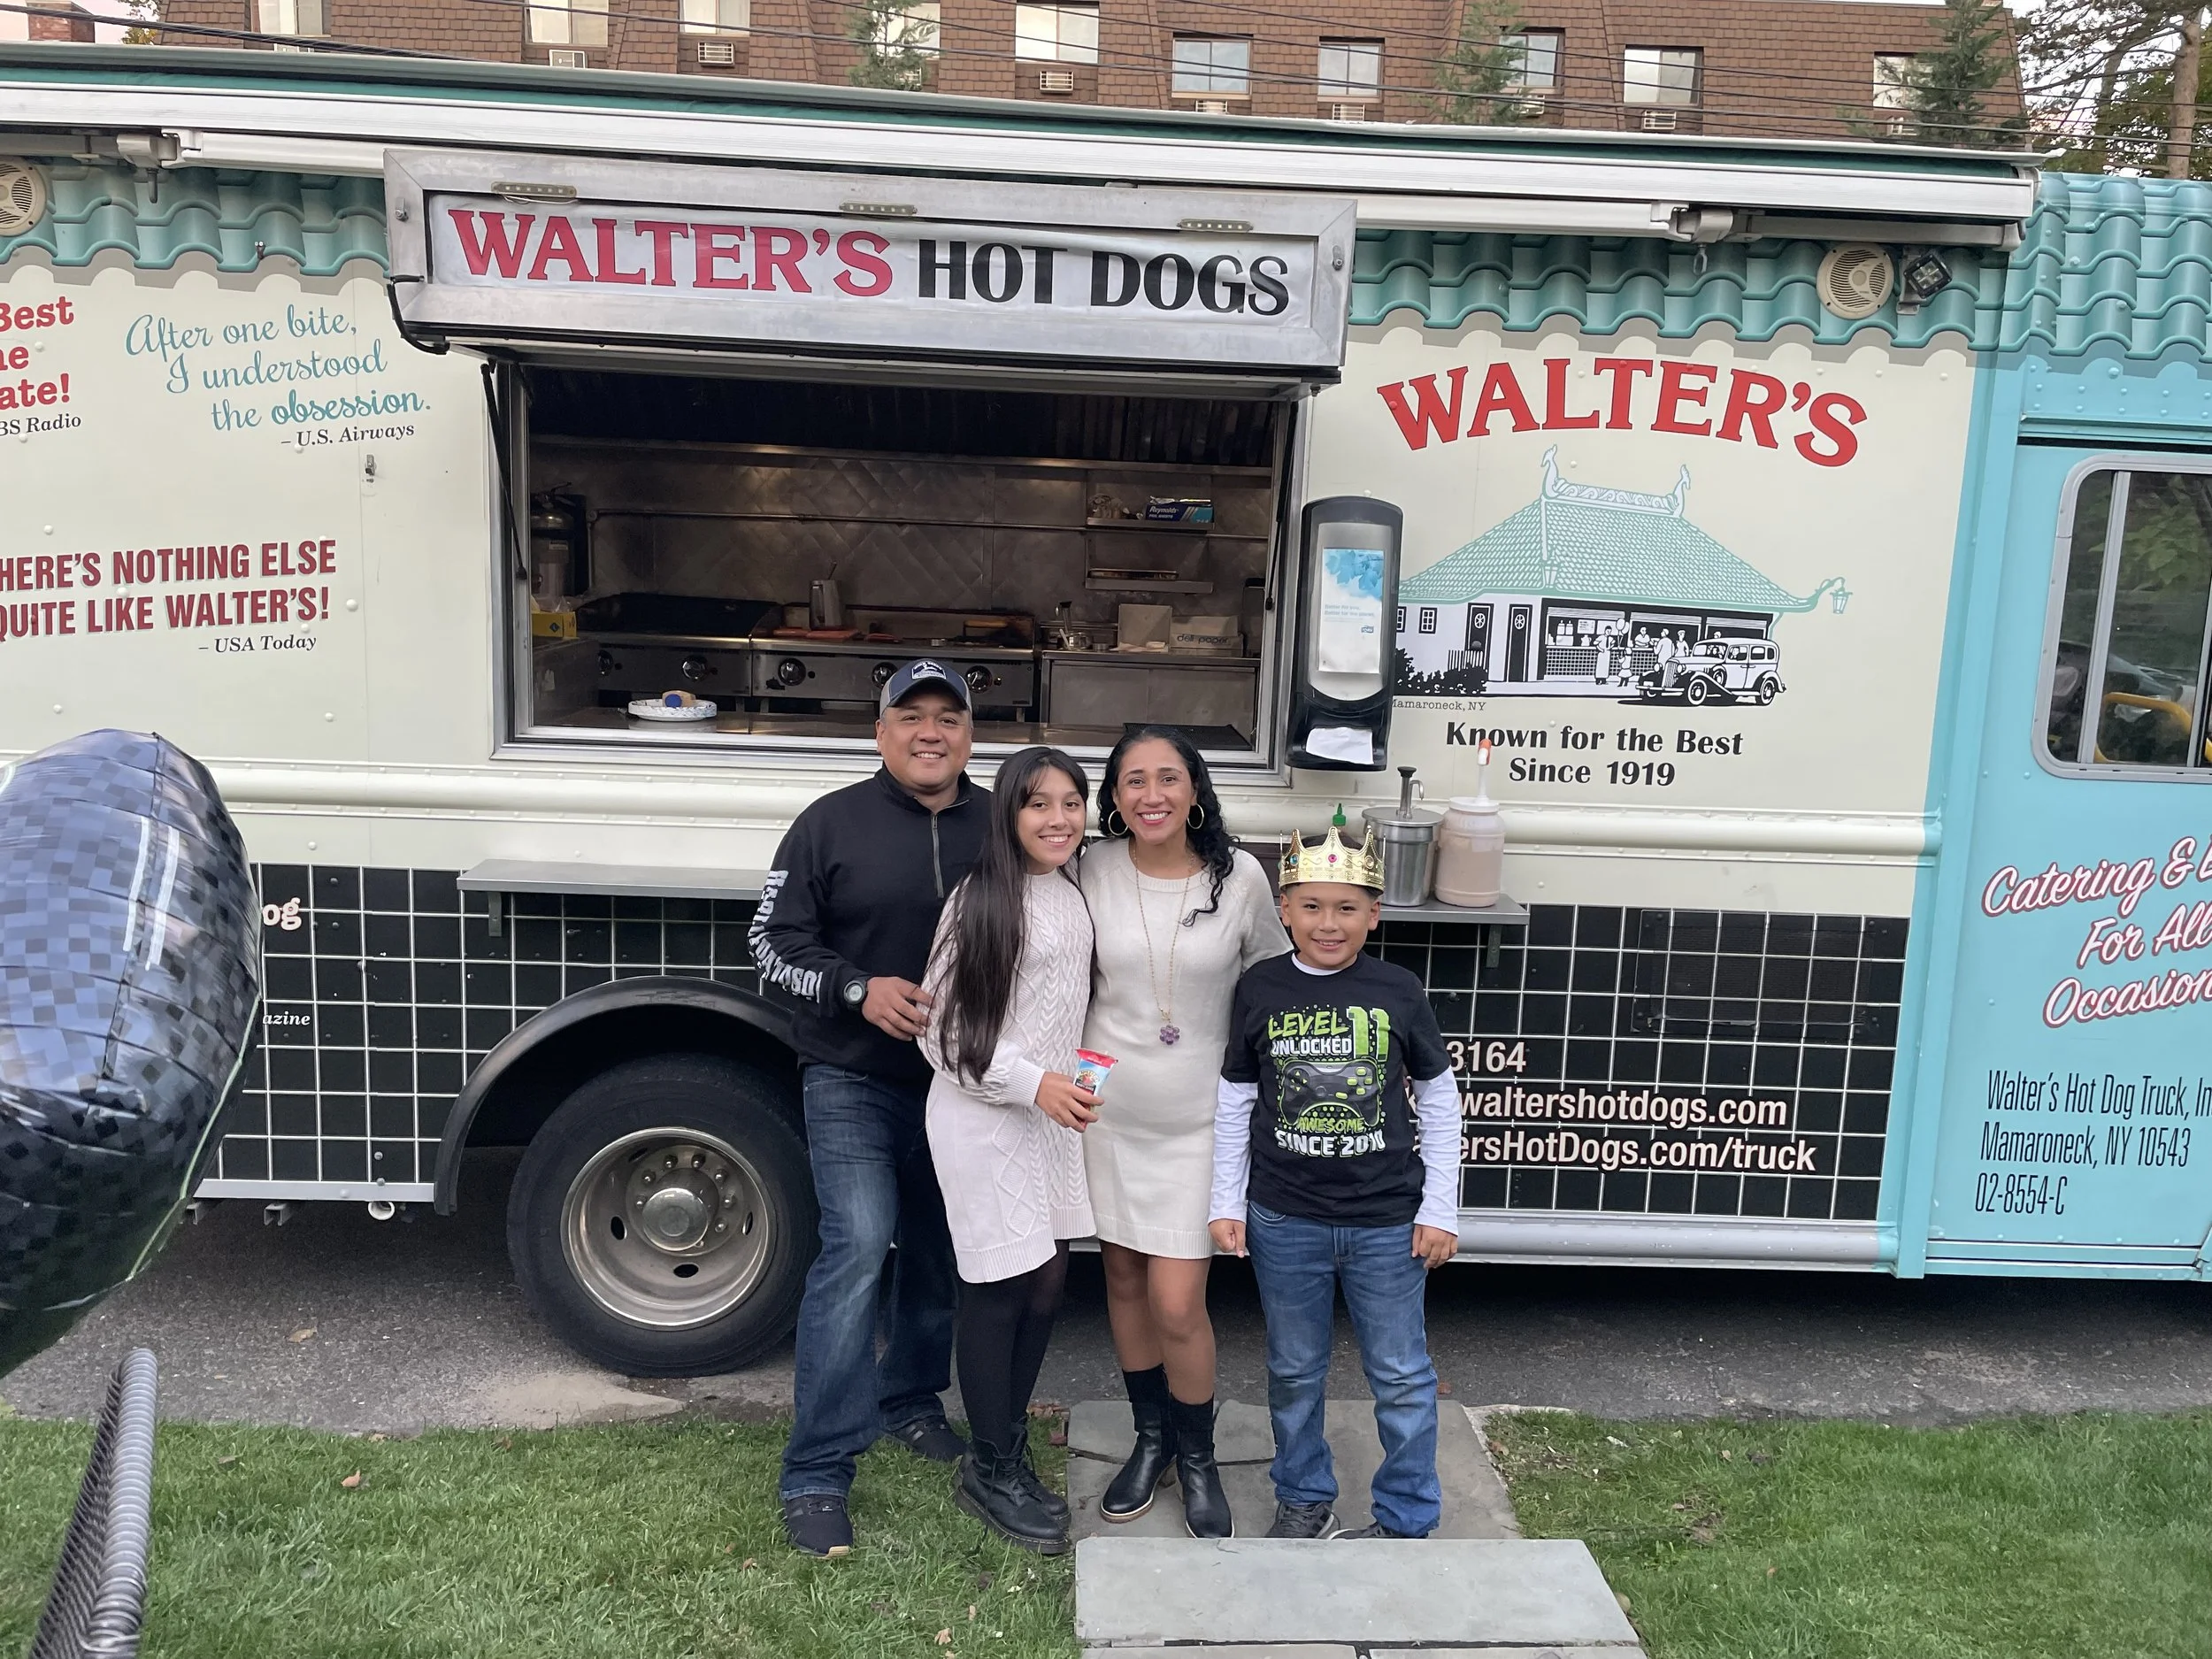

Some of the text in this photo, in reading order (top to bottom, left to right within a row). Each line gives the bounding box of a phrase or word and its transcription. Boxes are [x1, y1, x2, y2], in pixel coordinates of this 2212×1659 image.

[448, 210, 1289, 317] WALTER'S HOT DOGS
[125, 304, 358, 363] After one bite,
[166, 340, 389, 394] I understood
[0, 373, 70, 410] ate!
[211, 389, 433, 432] the obsession.
[1377, 357, 1868, 467] WALTER'S
[26, 412, 81, 433] Radio
[296, 426, 334, 447] U.S.
[339, 423, 415, 444] Airways
[0, 540, 336, 592] HERE'S NOTHING ELSE
[88, 596, 154, 633] LIKE
[165, 586, 330, 628] WALTER'S!
[214, 637, 255, 654] USA
[260, 634, 317, 652] Today
[1467, 701, 1487, 711] NY
[1446, 721, 1743, 757] Known for the Best
[1509, 756, 1676, 787] Since 1919
[1981, 856, 2157, 918] Catering
[2161, 834, 2197, 888] &
[262, 897, 303, 931] og
[2077, 900, 2212, 970] For All
[262, 1010, 311, 1026] azine
[2041, 967, 2212, 1029] Occasion
[1267, 1005, 1392, 1063] LEVEL 11
[1271, 1037, 1353, 1057] UNLOCKED
[1446, 1040, 1526, 1073] 3164
[1986, 1069, 2212, 1121] Walter's Hot Dog Truck, In
[1274, 1130, 1336, 1158] SINCE
[1337, 1130, 1386, 1158] 2010
[1296, 1116, 1365, 1134] AWESOME
[1980, 1120, 2193, 1170] Mamaroneck, NY 10543
[1974, 1172, 2069, 1217] 02-8554-C
